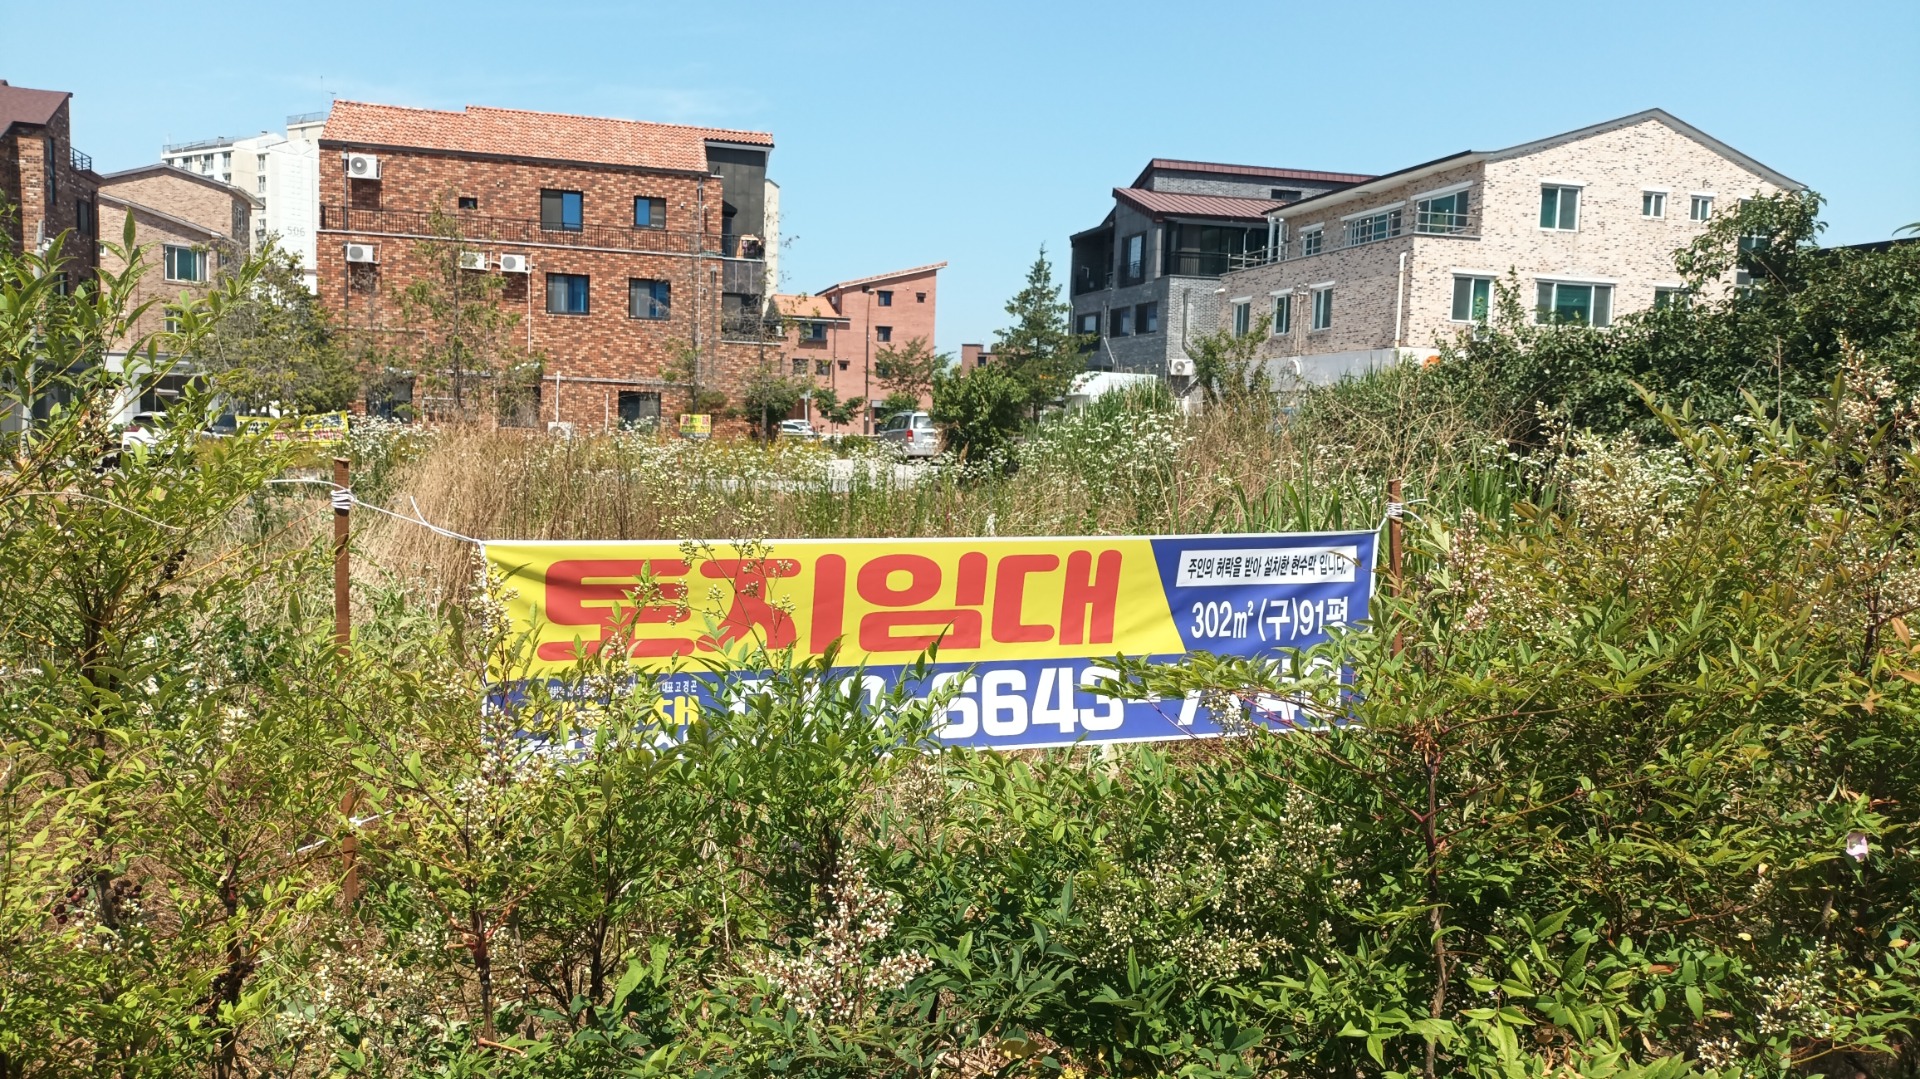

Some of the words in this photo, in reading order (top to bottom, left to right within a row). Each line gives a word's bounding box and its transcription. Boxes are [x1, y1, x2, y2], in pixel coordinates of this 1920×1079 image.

[287, 226, 306, 237] 506
[1187, 558, 1215, 579] 주인의
[1216, 556, 1242, 578] 허락을
[1244, 556, 1262, 578] 받아
[1264, 555, 1290, 577] 설치한
[1291, 554, 1317, 576] 현수막
[1319, 553, 1347, 576] 입니다.
[537, 550, 1123, 661] 토지임대
[727, 657, 1342, 746] 0-6643-74
